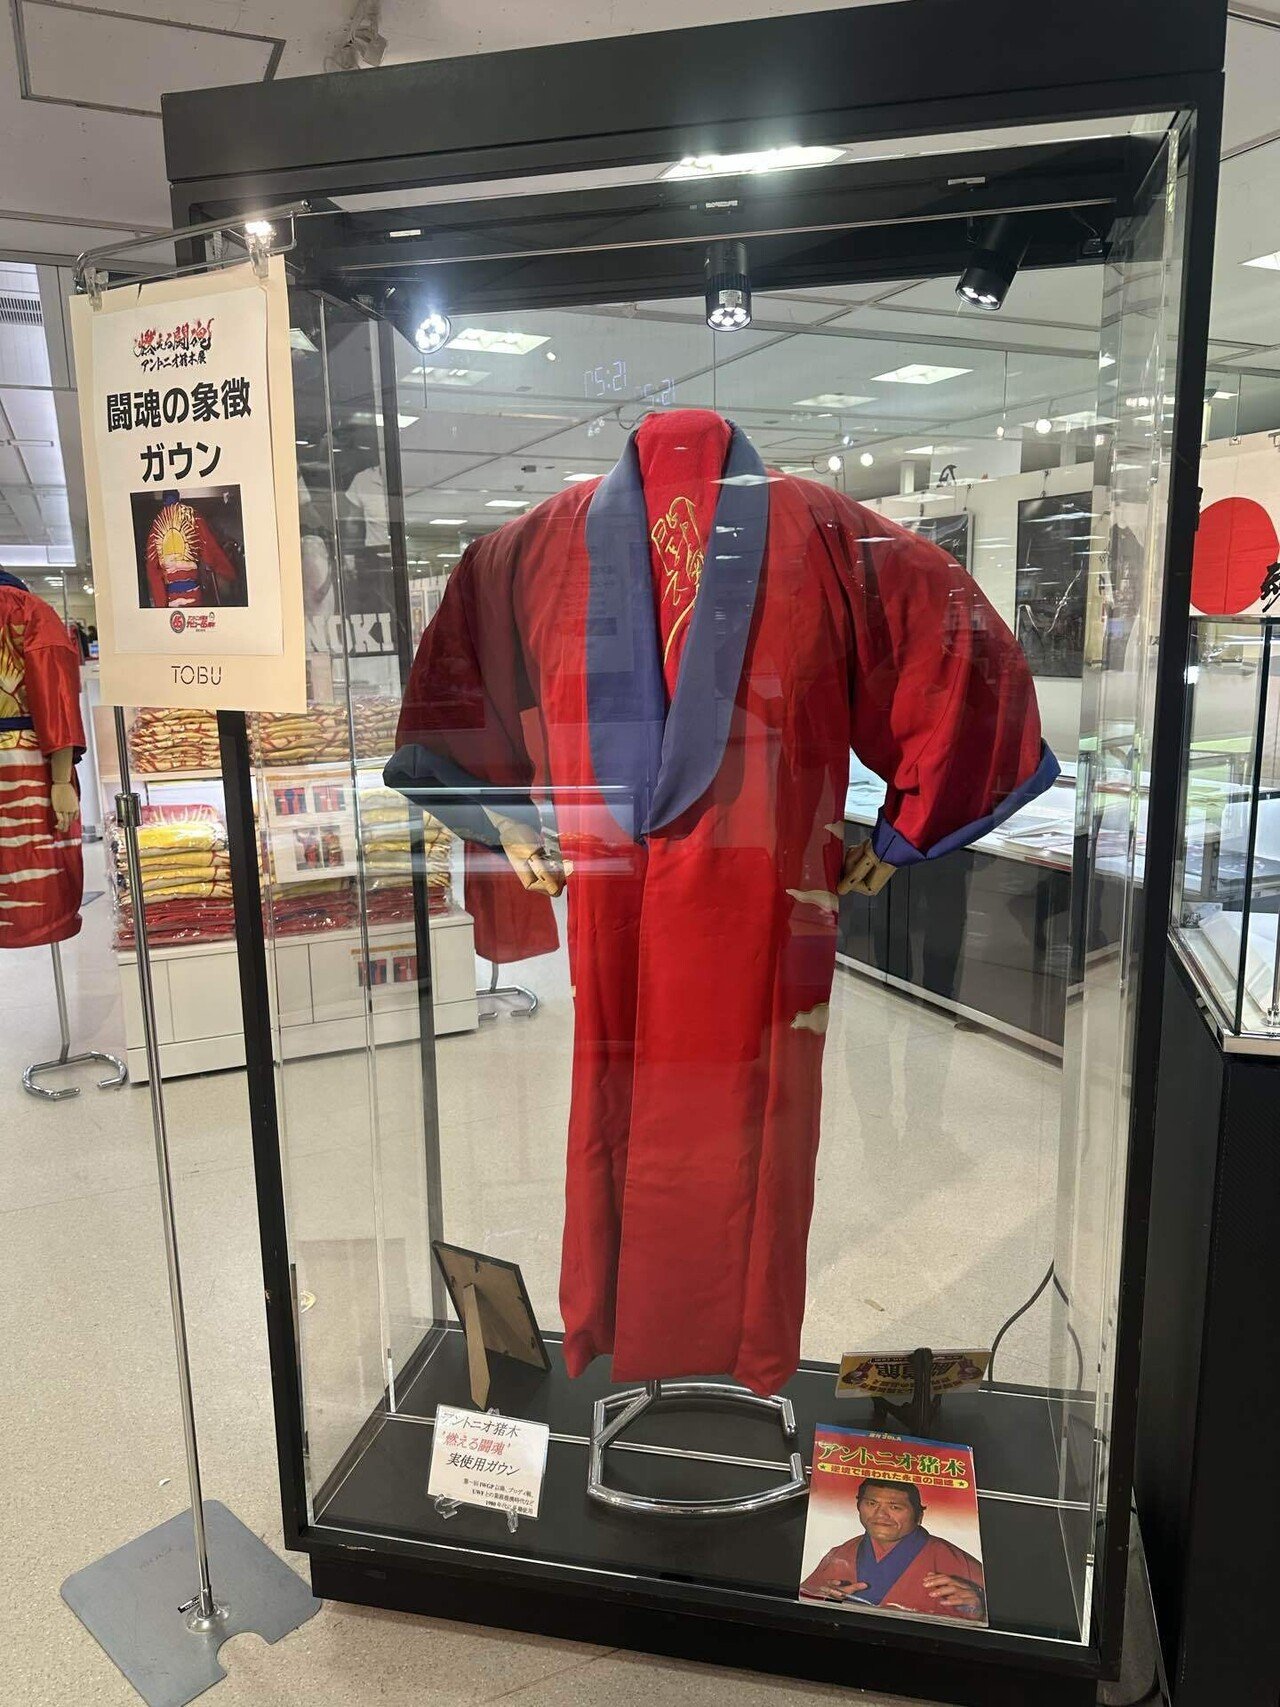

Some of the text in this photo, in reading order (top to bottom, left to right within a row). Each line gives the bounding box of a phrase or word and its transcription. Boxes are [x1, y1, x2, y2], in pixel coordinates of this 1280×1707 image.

[106, 377, 252, 433] 闘魂の象徴
[140, 441, 222, 483] ガウン
[171, 665, 222, 686] TOBU
[441, 1412, 520, 1438] アントニオ猪木
[446, 1452, 520, 1476] 実使用ガウン
[817, 1441, 966, 1477] アントニオ猪木
